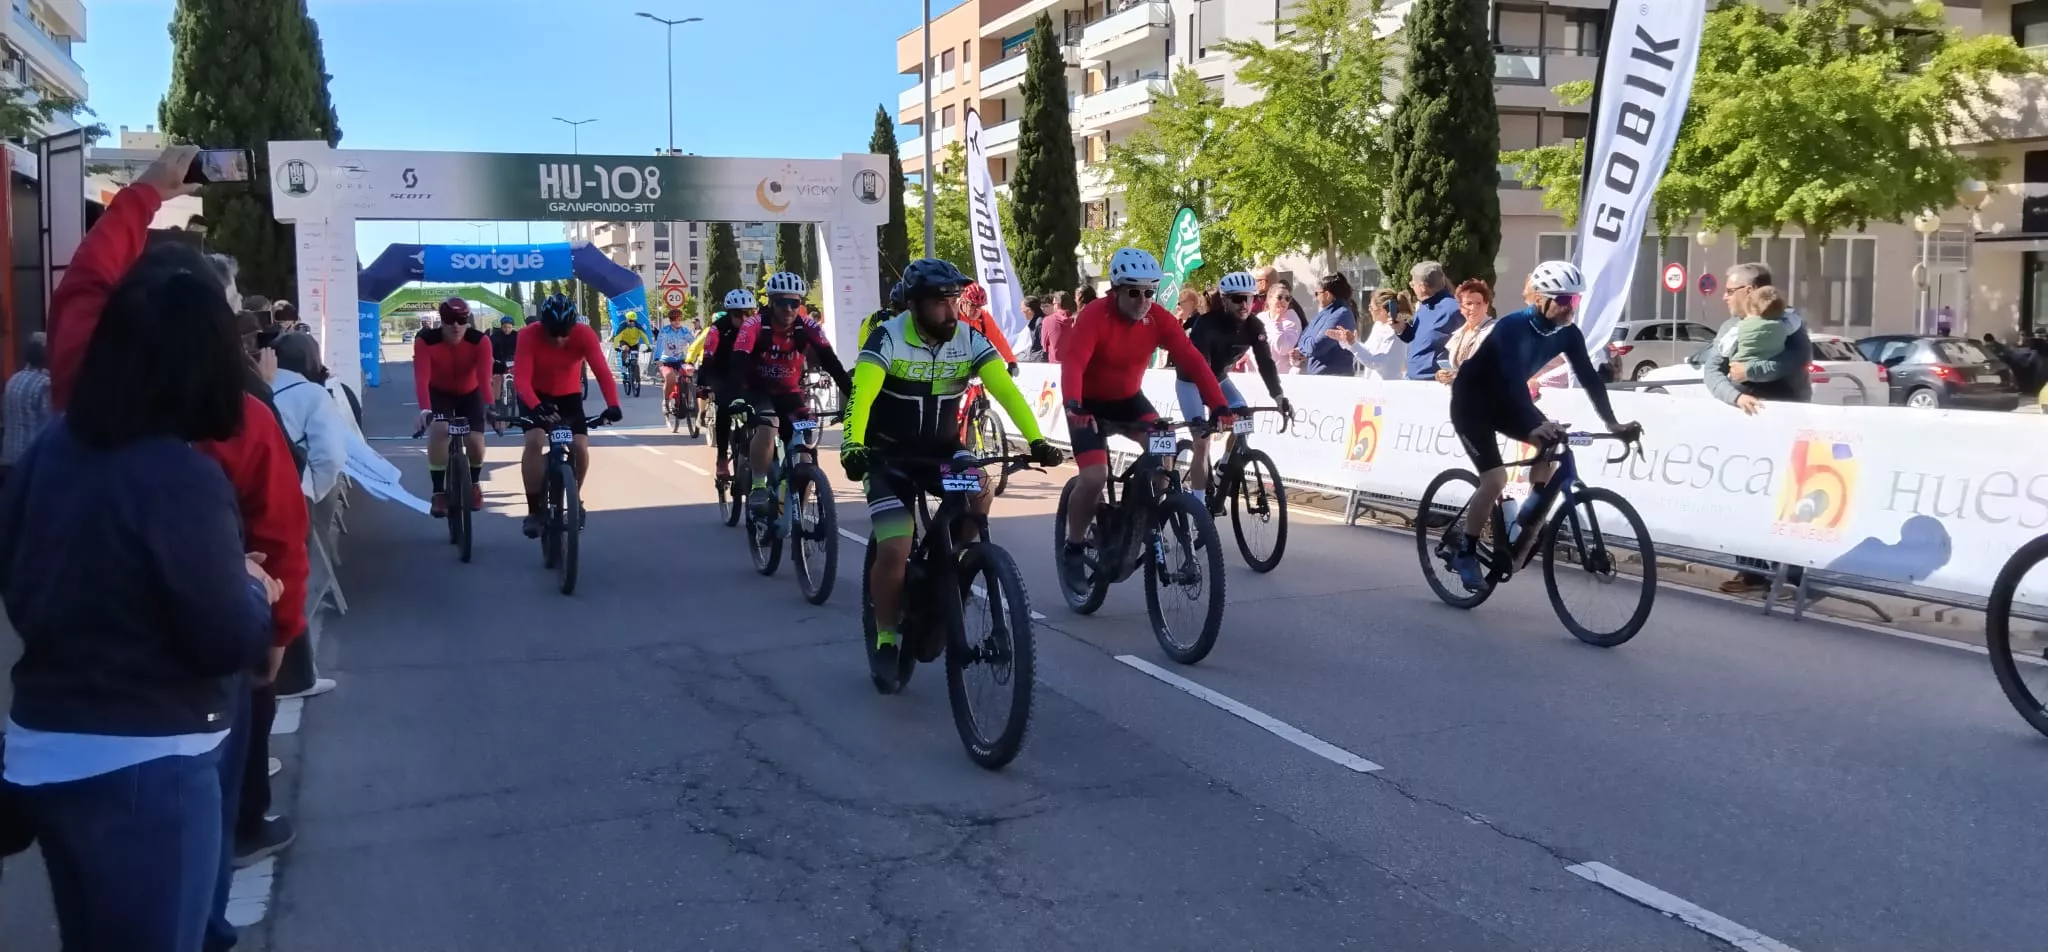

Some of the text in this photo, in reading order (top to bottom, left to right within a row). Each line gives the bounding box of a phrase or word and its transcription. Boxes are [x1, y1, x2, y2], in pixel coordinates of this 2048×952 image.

[1592, 24, 1680, 243] GOBIK
[539, 164, 661, 199] HU-108
[390, 192, 433, 200] SCOTT
[974, 186, 1008, 285] GOBIK
[668, 294, 682, 302] 20
[1234, 421, 1253, 431] 1115
[1153, 440, 1172, 449] 749
[1601, 442, 1774, 497] Huesca
